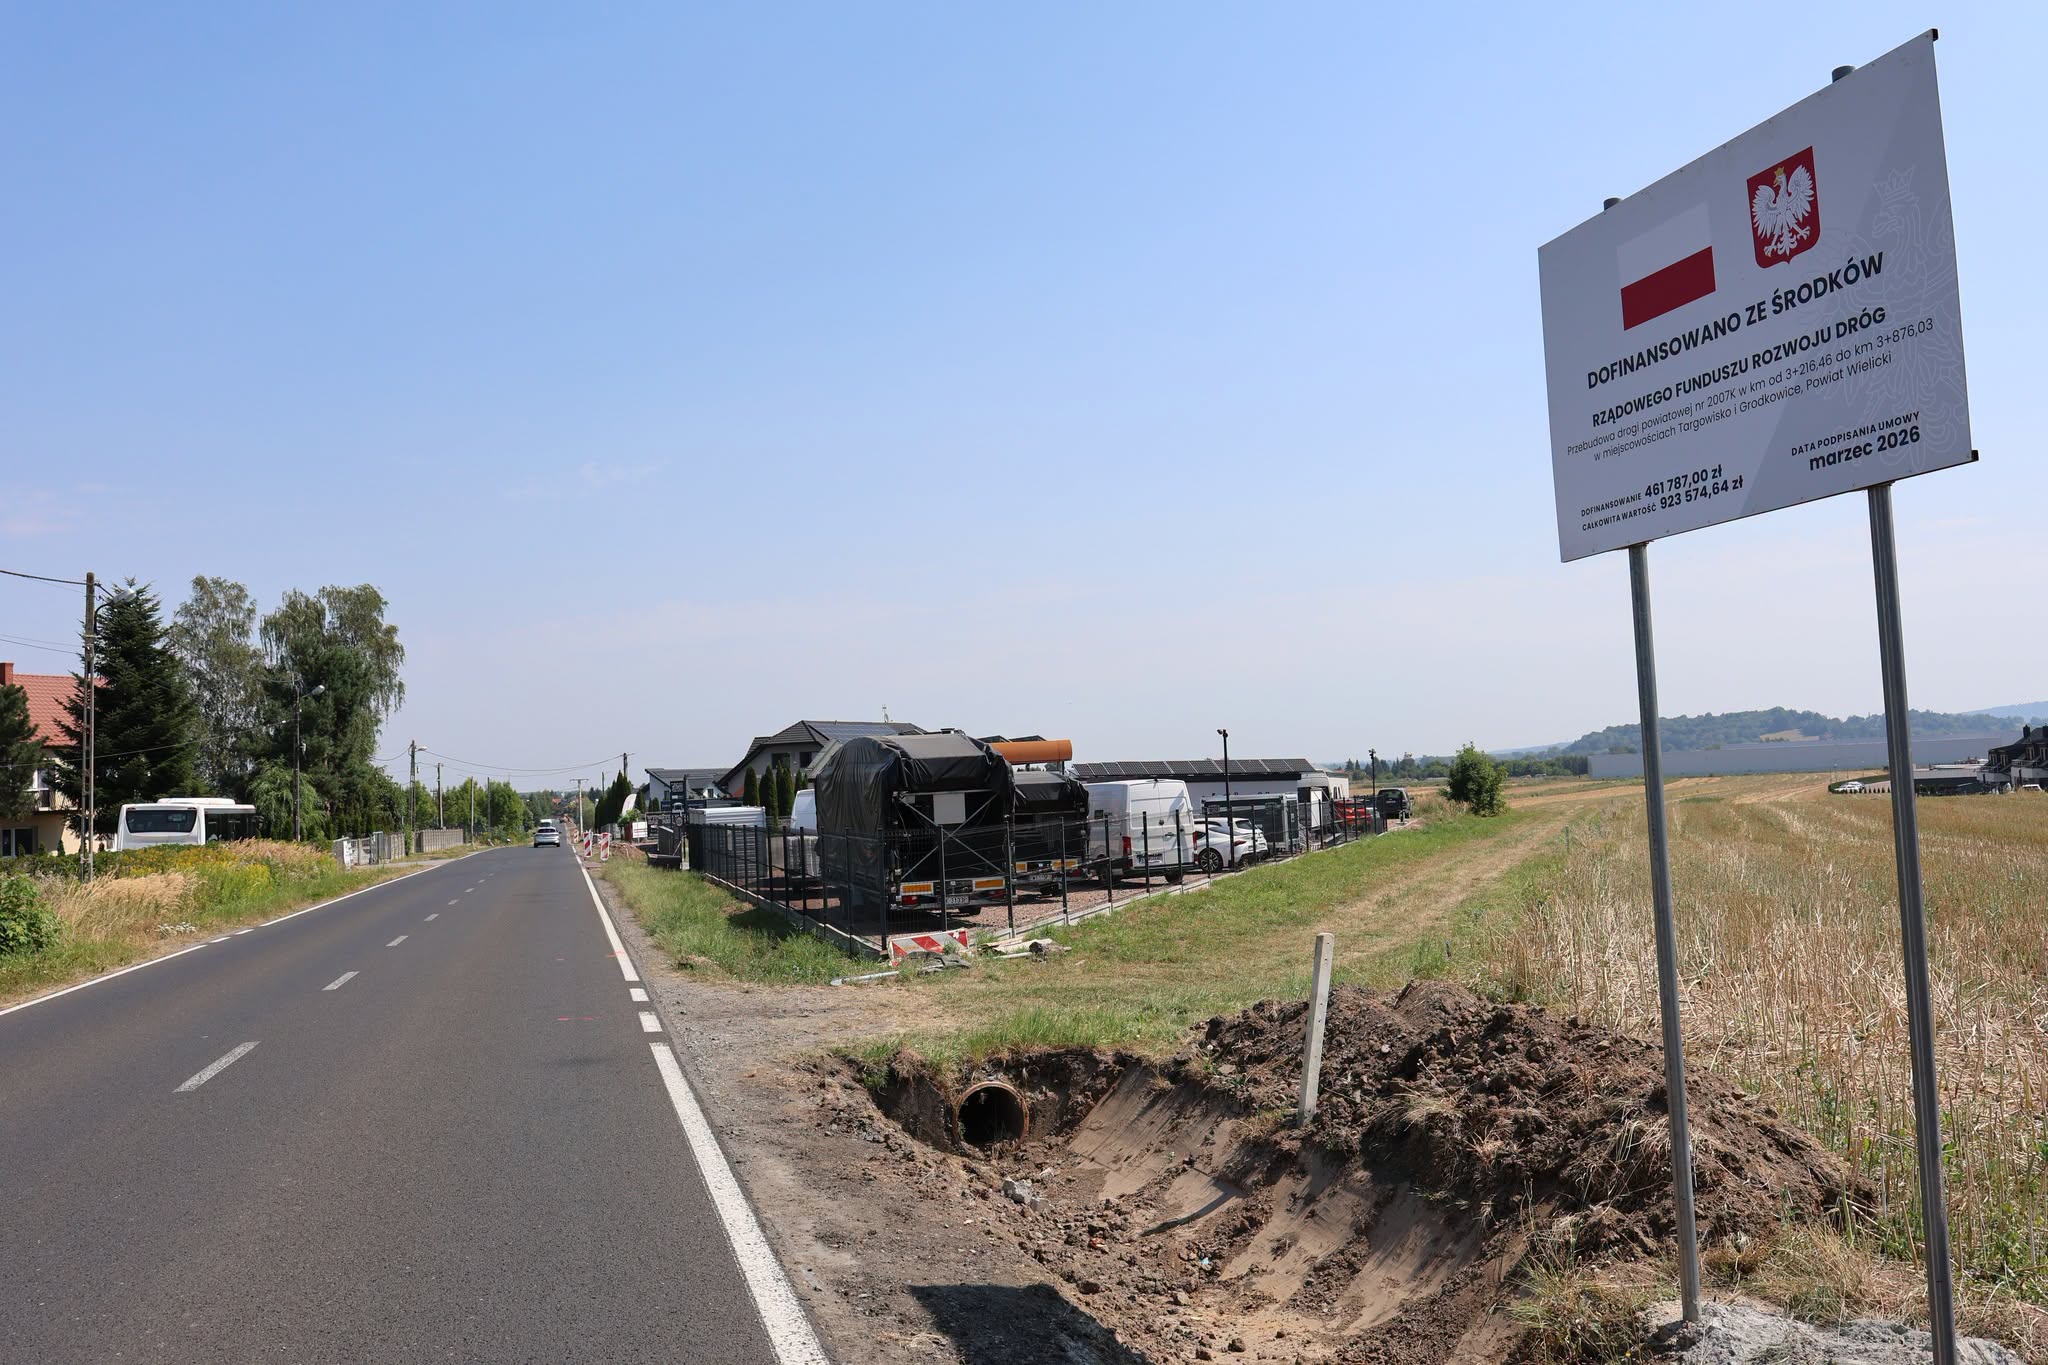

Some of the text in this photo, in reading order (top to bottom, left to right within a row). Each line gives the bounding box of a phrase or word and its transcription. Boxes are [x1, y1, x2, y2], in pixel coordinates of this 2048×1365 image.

[1587, 251, 1883, 389] DOFINANSOWANO ZE ŚRODKÓW
[1567, 318, 1934, 455] Przebudowa drogi powiatowej nr 2007K w km od 3+216,46 do km 3+876,03
[1592, 306, 1886, 427] RZĄDOWEGO FUNDUSZU ROZWOJU DRÓG
[1593, 350, 1892, 461] w miejscowościach Targowisko i Grodkowice, Powiat Wielicki
[1791, 411, 1920, 456] DATA PODPISANIA UMOWY
[1809, 425, 1920, 471] marzec 2026
[1581, 464, 1723, 517] DOFINANSOWANIE 461 787,00 zł
[1582, 474, 1744, 531] CAŁKOWITA WARTOŚĆ 923 574,64 zł
